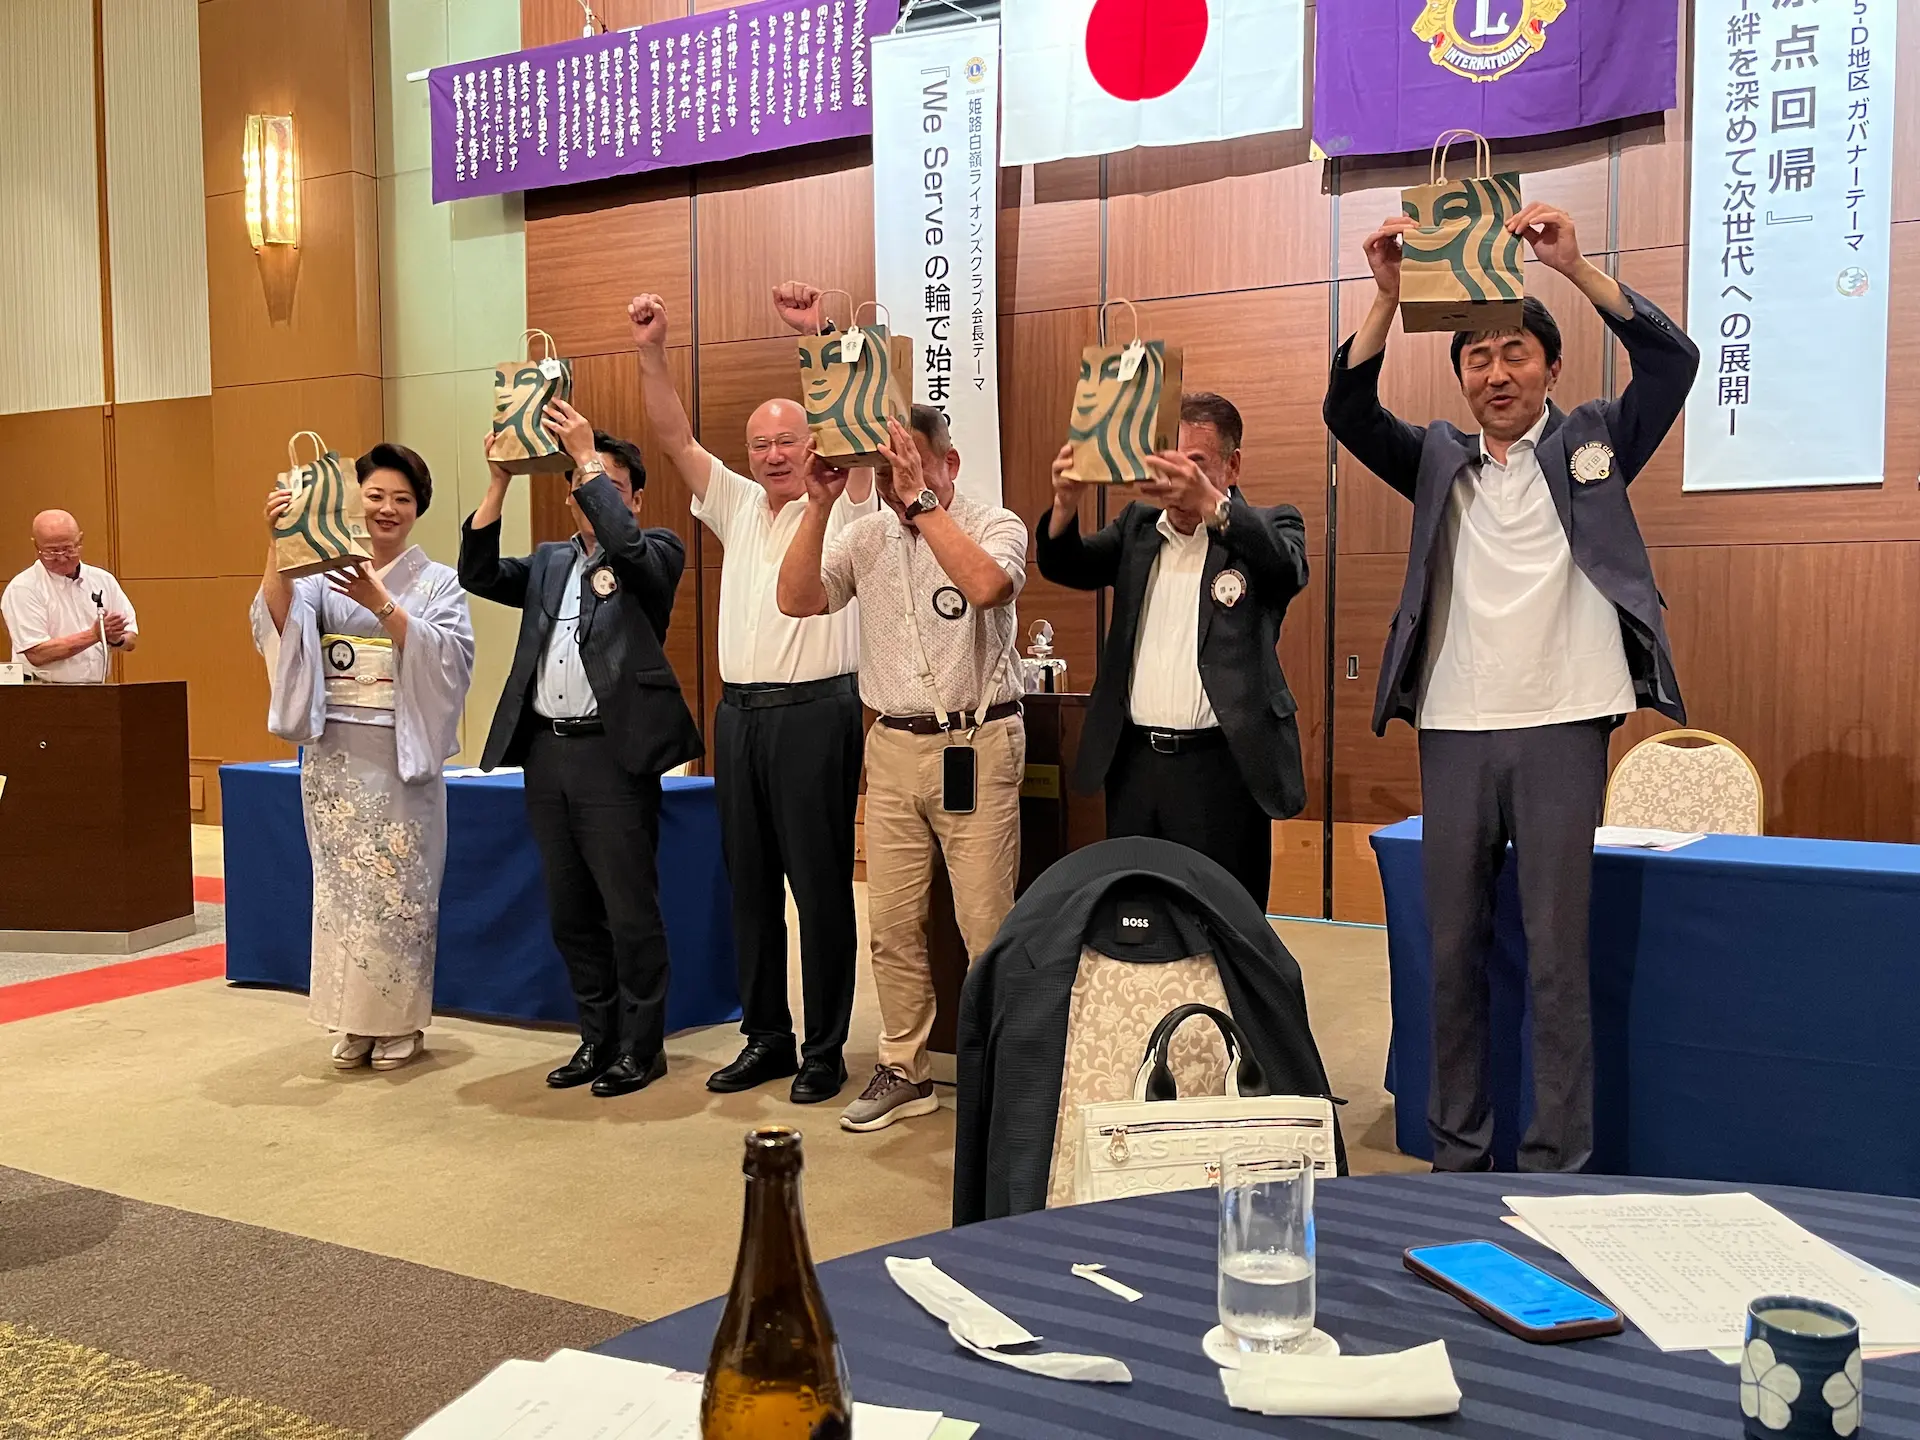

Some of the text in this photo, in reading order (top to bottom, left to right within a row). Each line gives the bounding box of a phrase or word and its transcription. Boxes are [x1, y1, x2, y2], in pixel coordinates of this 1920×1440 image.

[801, 8, 810, 31] 自由
[1470, 0, 1509, 38] L
[1444, 38, 1531, 71] INTERNATIONAL
[537, 69, 549, 155] また会う日まで
[1843, 99, 1871, 253] ガバナーテーマ
[924, 146, 949, 247] Serve
[968, 98, 988, 391] 姫路白嶺ライオンズクラブ会長テーマ
[1122, 917, 1149, 928] BOSS
[1104, 1132, 1327, 1162] ASTELBAJAC
